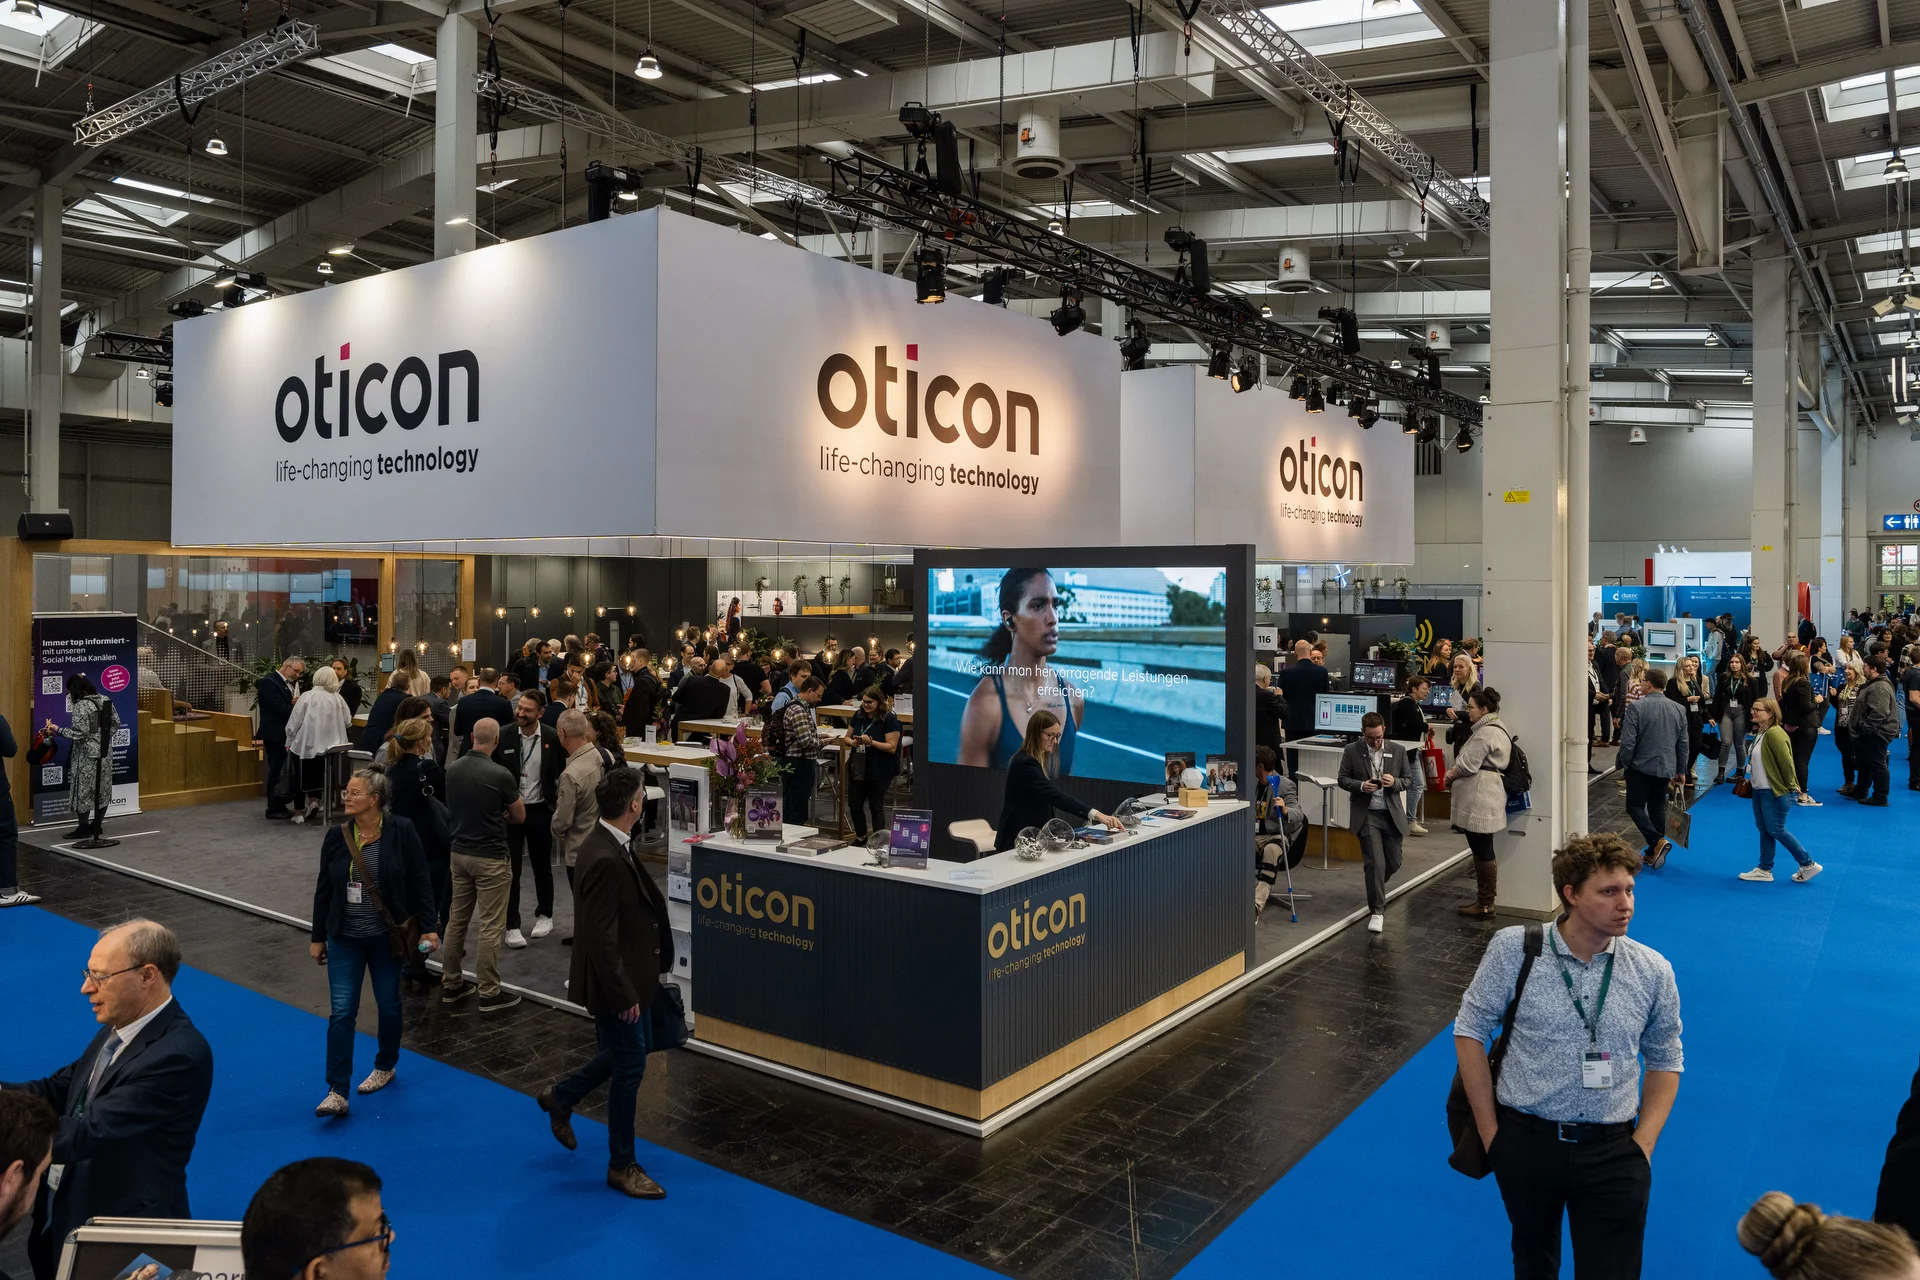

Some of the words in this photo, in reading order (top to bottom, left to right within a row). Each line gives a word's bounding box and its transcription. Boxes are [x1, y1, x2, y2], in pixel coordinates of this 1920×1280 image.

[275, 342, 480, 443] oticon
[817, 344, 1040, 455] oticon
[275, 456, 373, 483] life-changing
[377, 446, 480, 475] technology
[820, 446, 944, 487] life-changing
[950, 463, 1040, 496] technology
[1280, 436, 1363, 501] oticon
[1280, 503, 1326, 525] life-changing
[1327, 510, 1364, 528] technology
[42, 639, 69, 647] Immer
[70, 639, 84, 647] top
[85, 637, 125, 645] informiert
[56, 647, 86, 655] unseren
[1258, 635, 1271, 644] 116
[42, 655, 64, 664] Social
[65, 655, 87, 663] Media
[88, 654, 117, 662] Kanälen
[955, 661, 977, 674] Wie
[979, 664, 1006, 676] kann
[1008, 666, 1032, 677] man
[1035, 665, 1118, 683] hervorragende
[1121, 670, 1189, 687] Leistungen
[1037, 685, 1095, 698] erreichen?
[697, 873, 815, 931] oticon
[697, 914, 757, 939] life-changing
[758, 928, 815, 952] technology
[987, 892, 1086, 959] oticon
[988, 952, 1042, 982] life-changing
[1043, 933, 1086, 959] technology
